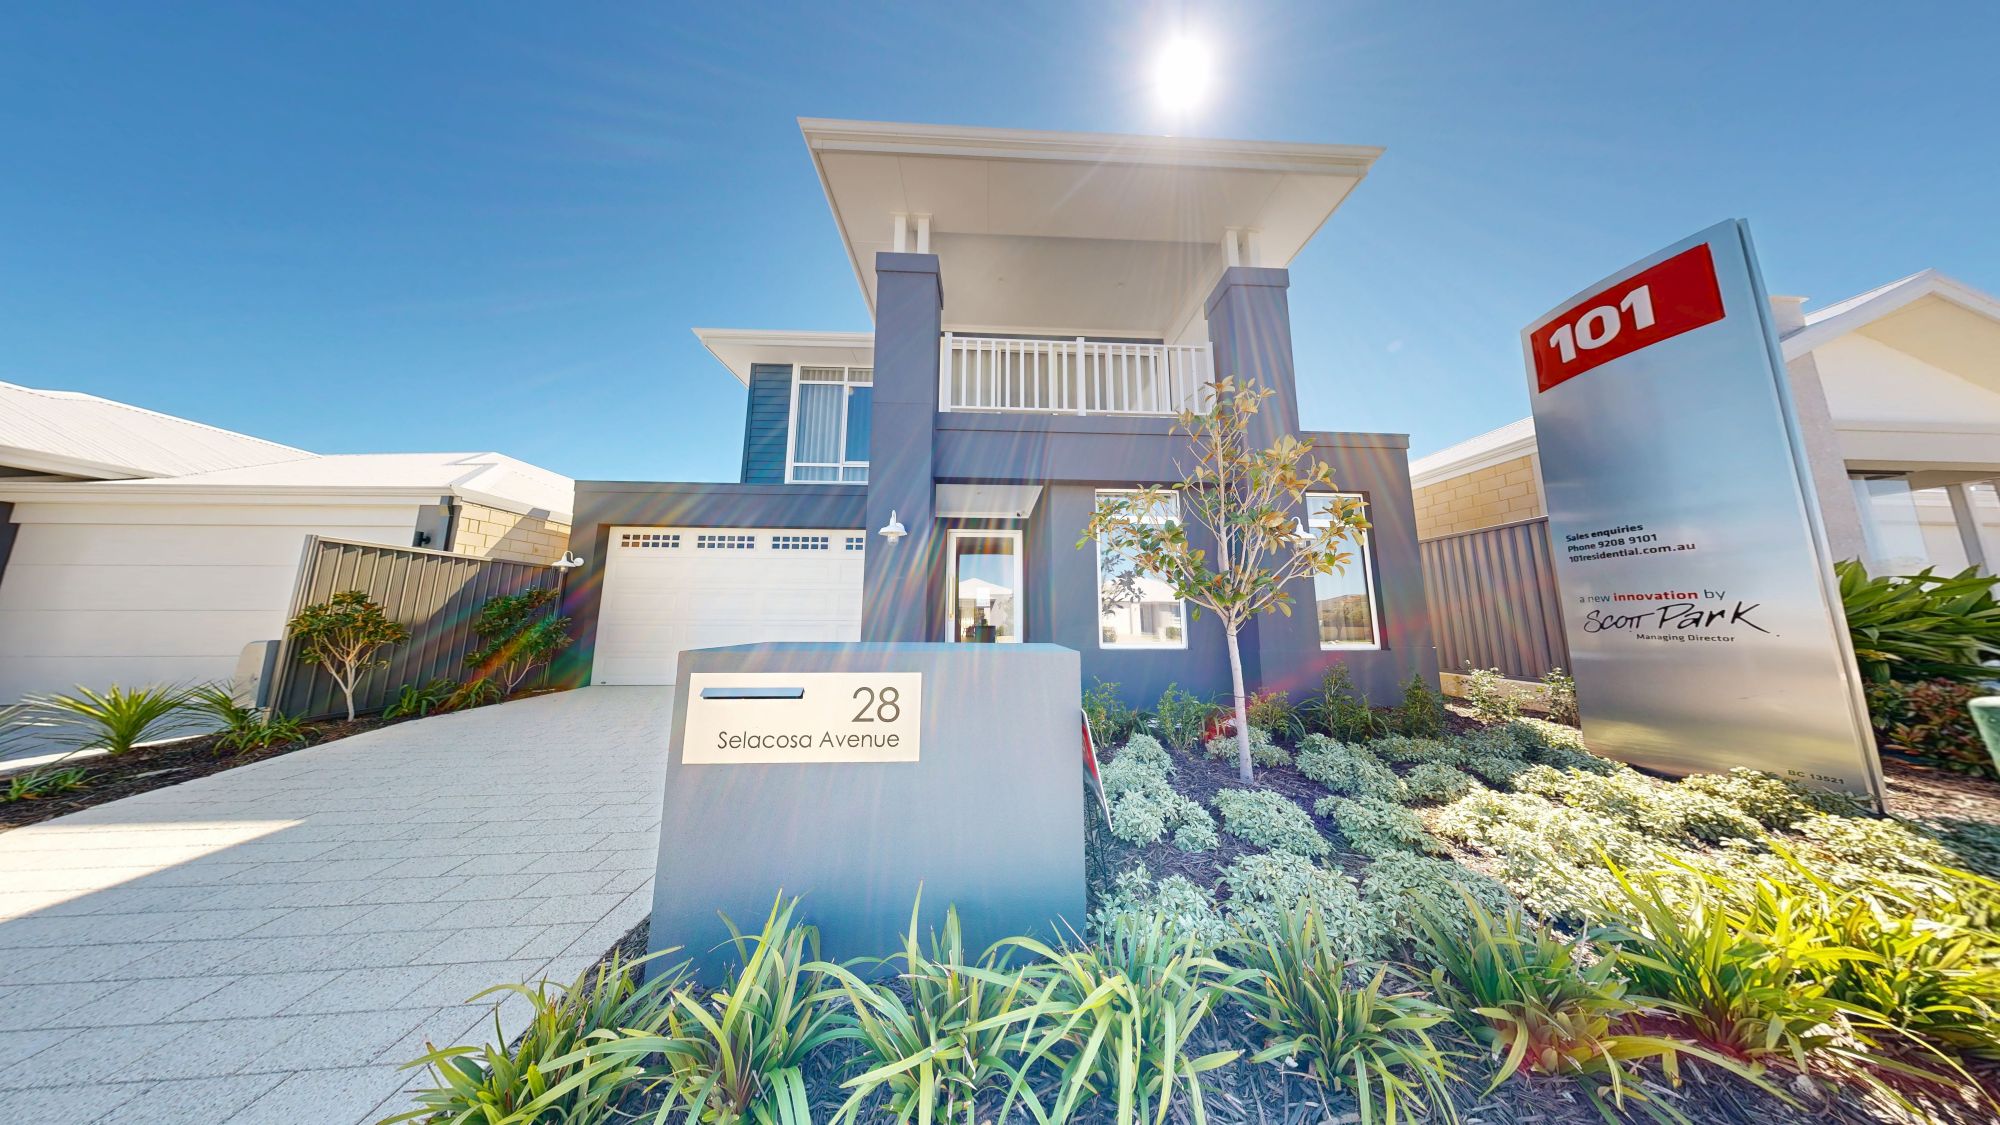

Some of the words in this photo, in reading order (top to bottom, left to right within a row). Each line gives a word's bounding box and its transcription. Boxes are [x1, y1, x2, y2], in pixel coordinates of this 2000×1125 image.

[1549, 284, 1655, 363] 101
[1565, 533, 1590, 543] Sales
[1590, 523, 1644, 538] enquiries
[1567, 542, 1597, 553] Phone
[1597, 537, 1626, 549] 9208
[1628, 533, 1658, 545] 9101
[1568, 542, 1696, 564] 101residential.com.au
[1578, 595, 1586, 604] a
[1587, 593, 1611, 603] new
[1612, 589, 1699, 602] innovation
[1703, 588, 1726, 601] by
[1636, 632, 1686, 643] Managing
[1687, 633, 1736, 643] Director
[852, 686, 900, 723] 28
[717, 730, 812, 750] Selacosa
[818, 730, 900, 748] Avenue
[1788, 769, 1805, 778] BC
